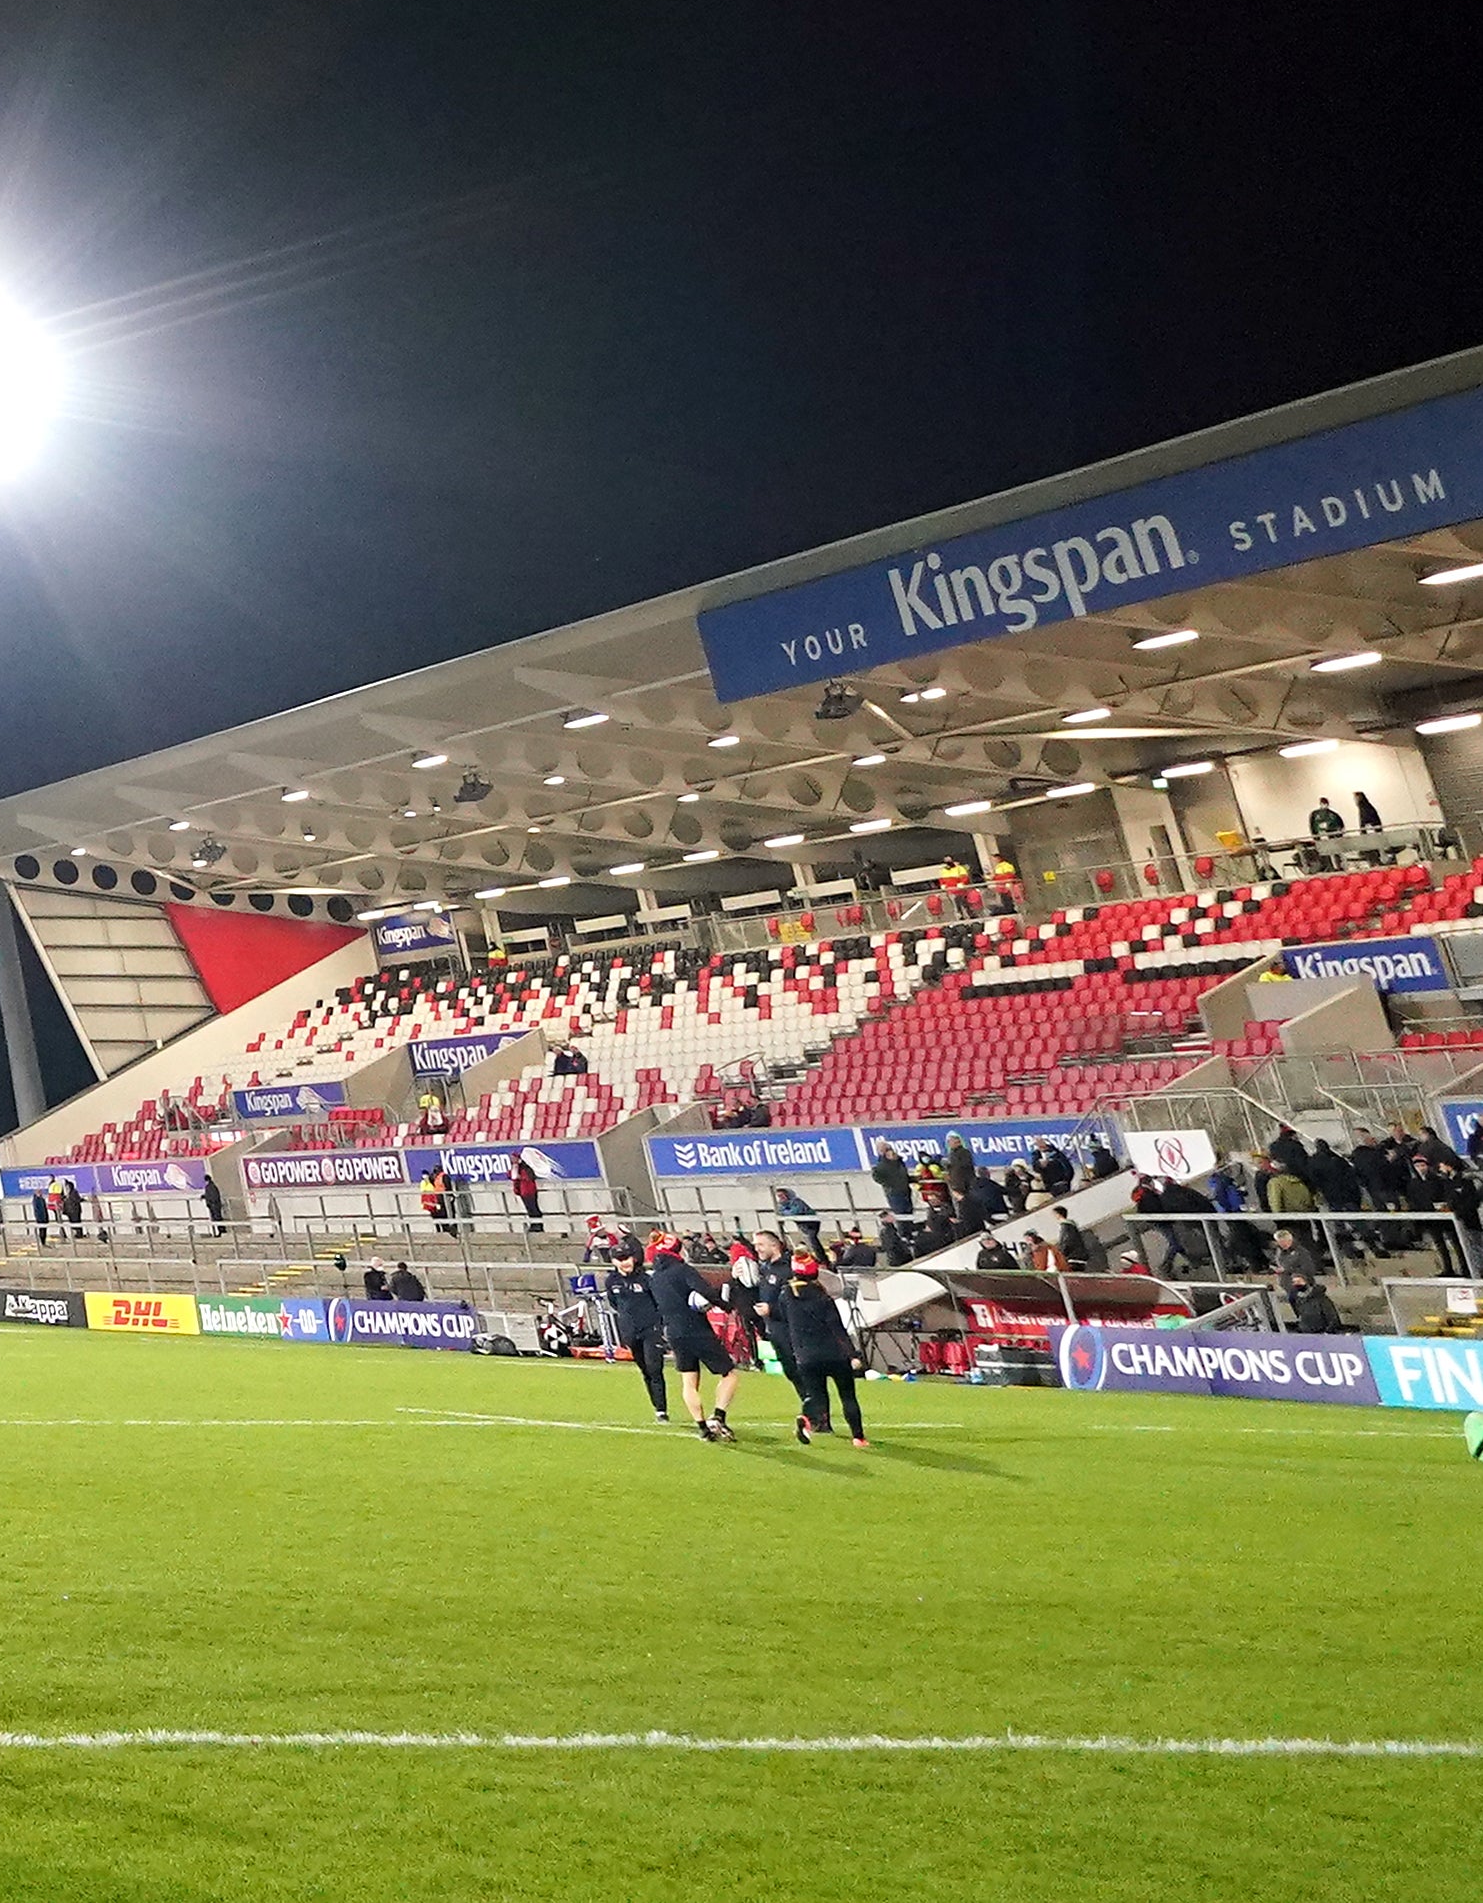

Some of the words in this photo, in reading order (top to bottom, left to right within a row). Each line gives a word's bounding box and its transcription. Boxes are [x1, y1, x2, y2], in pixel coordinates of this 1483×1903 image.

[780, 621, 869, 666] YOUR
[887, 512, 1191, 634] Kingspan
[1228, 468, 1447, 553] STADIUM
[377, 923, 426, 947] Kingspan
[412, 1042, 488, 1077] Kingspan
[245, 1090, 293, 1116] Kingspan
[698, 1141, 743, 1168] Bank
[744, 1140, 763, 1165] of
[765, 1137, 832, 1166] Ireland
[970, 1135, 1024, 1154] PLANET
[112, 1166, 162, 1192] Kingspan
[259, 1161, 280, 1183] GO
[279, 1159, 321, 1183] POWER
[334, 1158, 355, 1182] GO
[354, 1156, 402, 1181] POWER
[439, 1149, 512, 1182] Kingspan
[112, 1300, 170, 1328] DHL
[198, 1303, 280, 1334] Heineken
[354, 1309, 442, 1337] CHAMPIONS
[442, 1313, 476, 1339] CUP
[1111, 1341, 1292, 1384] CHAMPIONS
[1295, 1350, 1363, 1386] CUP
